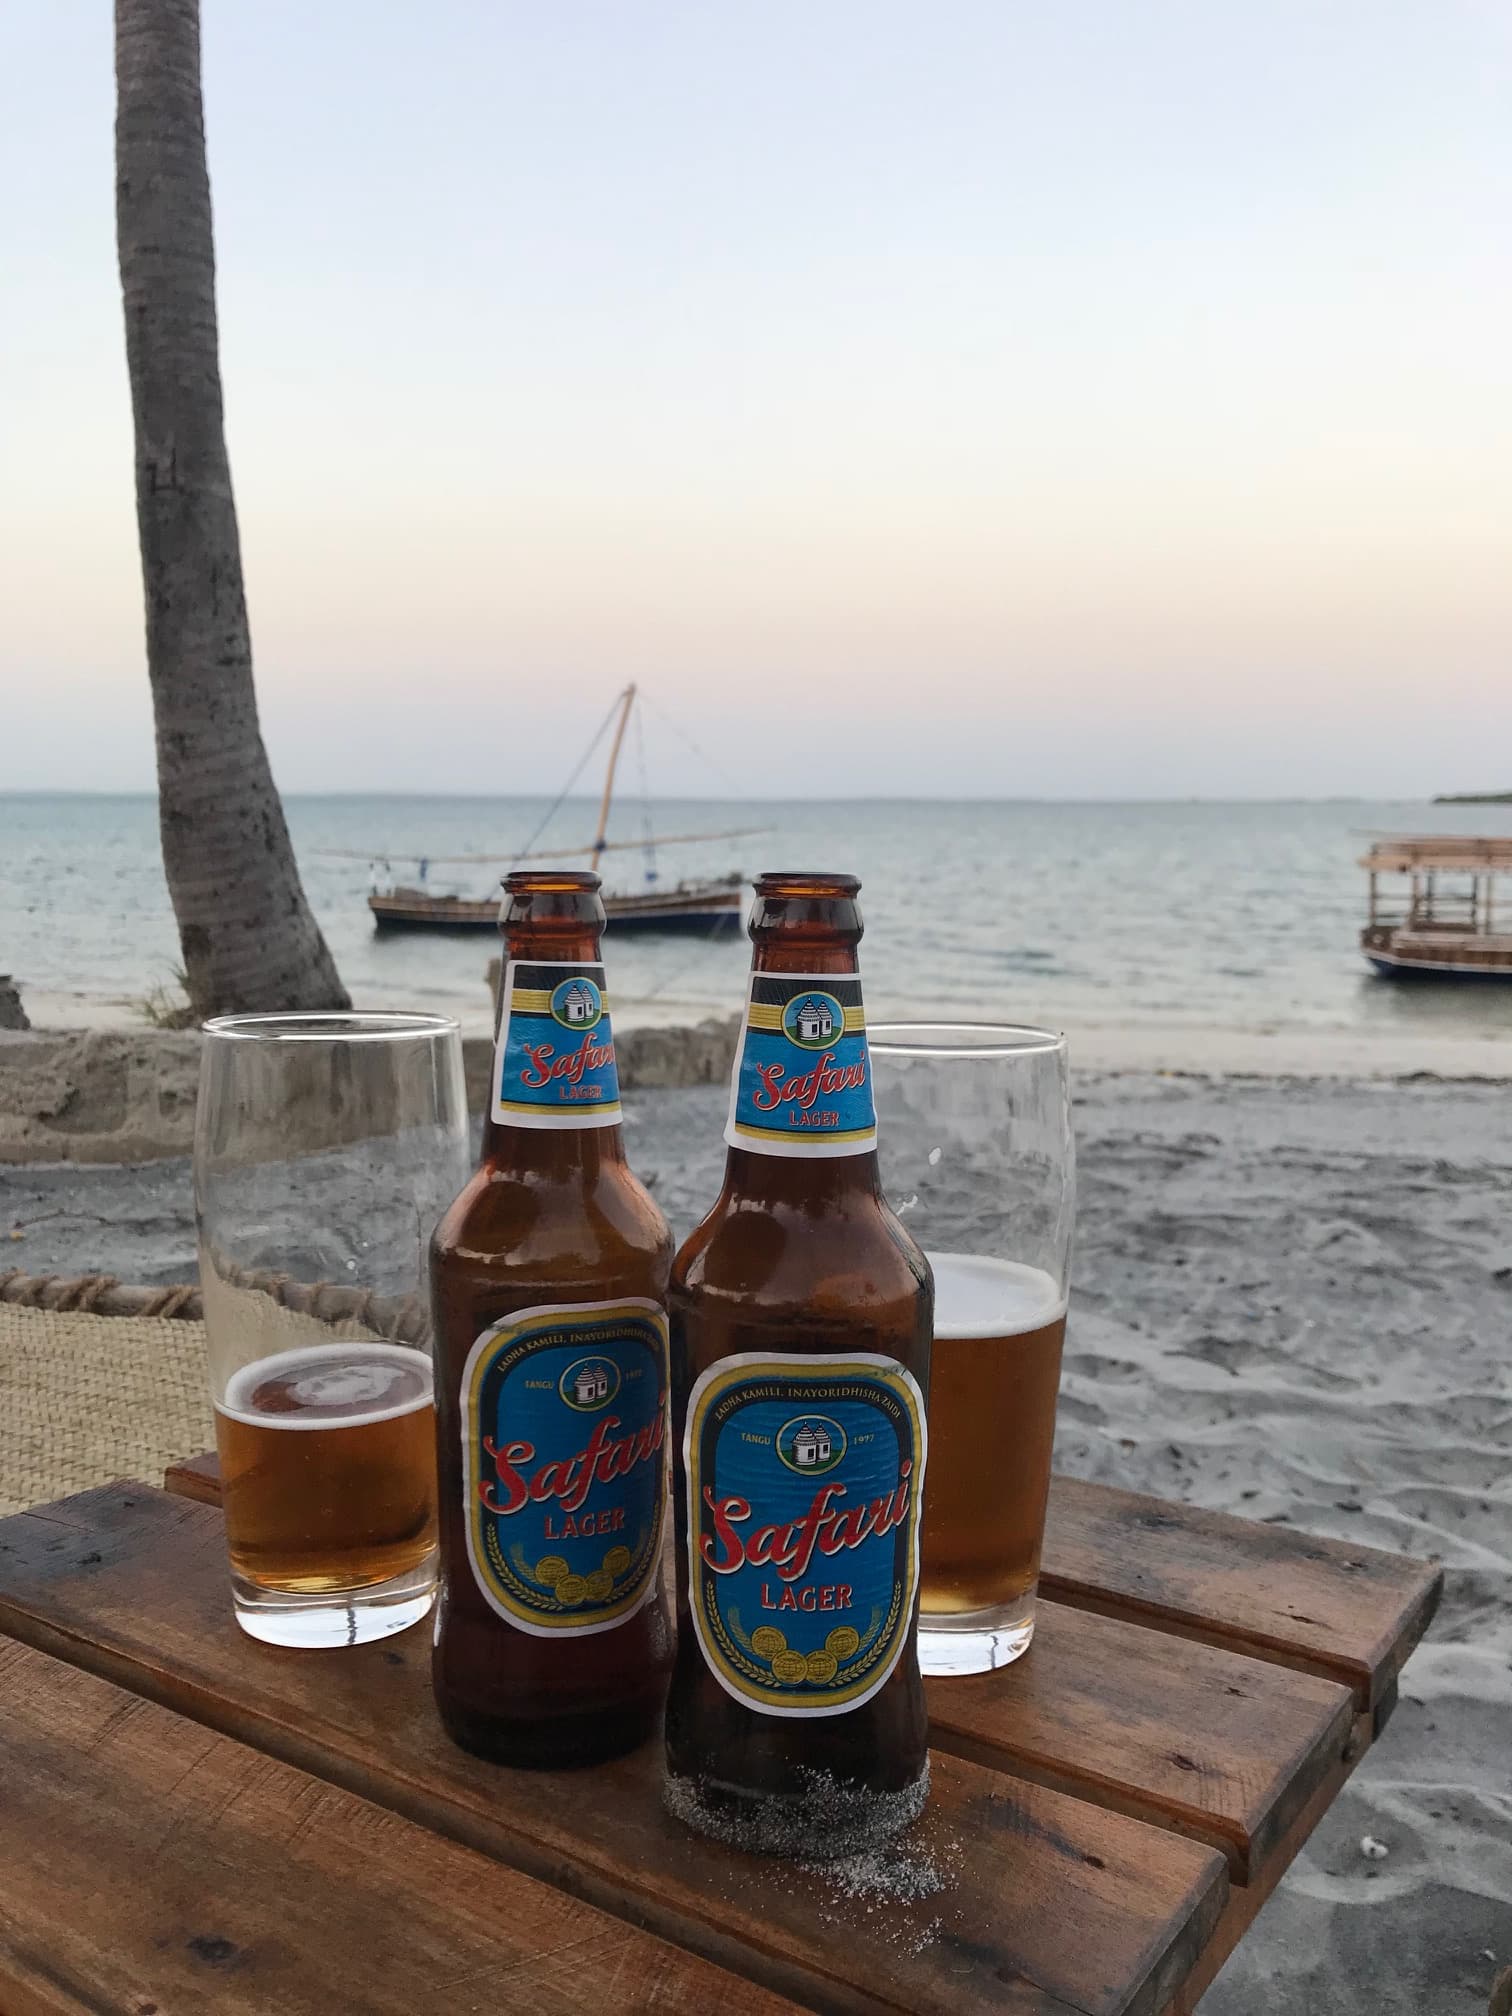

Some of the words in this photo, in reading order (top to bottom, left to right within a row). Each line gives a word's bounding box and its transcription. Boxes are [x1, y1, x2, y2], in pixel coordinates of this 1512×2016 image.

[559, 1084, 602, 1100] LAGER
[752, 1051, 866, 1111] Safari
[789, 1110, 840, 1127] LAGER
[714, 1395, 742, 1420] LADHA
[787, 1385, 881, 1402] INAYORIDHISHA
[880, 1395, 901, 1419] ZAIDI
[477, 1391, 666, 1515] Safari
[741, 1432, 771, 1446] TANGU
[853, 1433, 875, 1445] 1977
[543, 1507, 626, 1540] LAGER
[699, 1458, 912, 1582] Safari
[760, 1583, 853, 1612] LAGER
